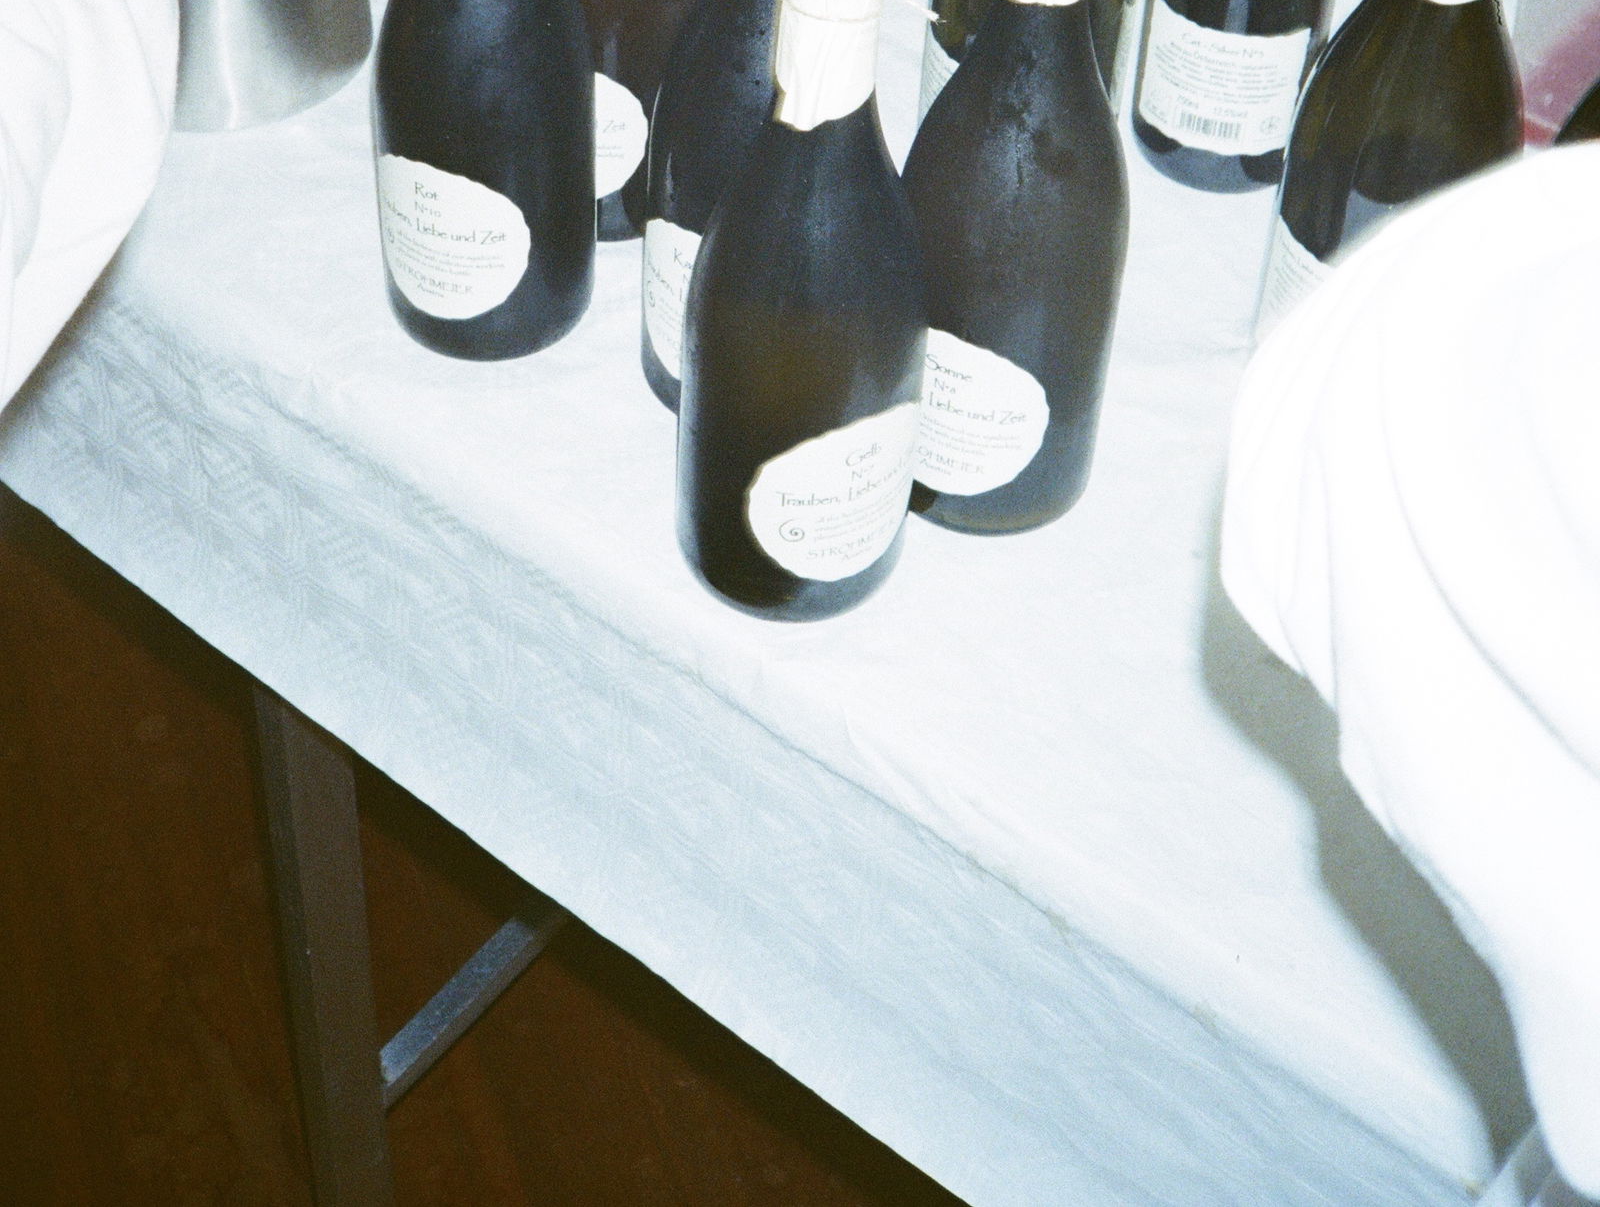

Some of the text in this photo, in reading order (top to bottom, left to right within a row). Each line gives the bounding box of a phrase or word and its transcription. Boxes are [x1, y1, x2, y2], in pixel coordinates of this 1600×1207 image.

[414, 181, 439, 201] Rot
[416, 218, 448, 240] Liebe
[451, 230, 476, 243] und
[480, 230, 507, 245] Zeit
[924, 354, 973, 384] Sonne
[929, 392, 1027, 425] Liebe und Zeit
[776, 491, 841, 507] Trauben,
